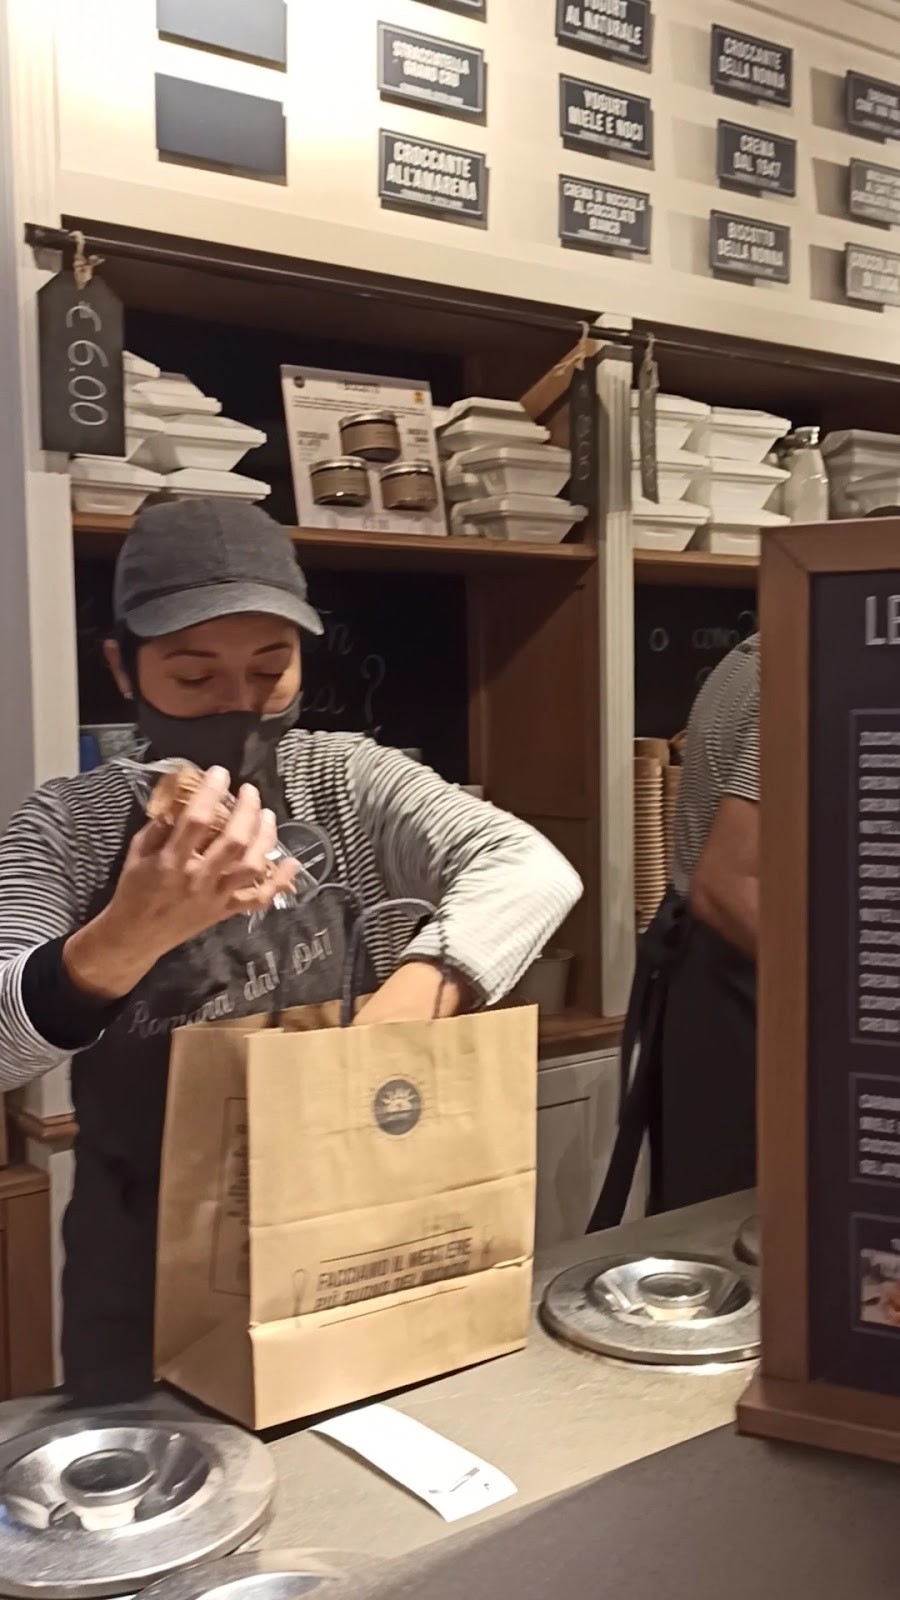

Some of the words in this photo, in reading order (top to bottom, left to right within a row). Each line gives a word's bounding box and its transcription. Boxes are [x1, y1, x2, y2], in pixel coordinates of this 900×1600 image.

[724, 37, 782, 70] CROCCANTE
[583, 90, 628, 117] YOGURT
[568, 106, 604, 132] MIELE
[605, 116, 614, 134] E
[616, 119, 643, 142] NOCI
[393, 141, 472, 178] CROCCANTE
[740, 135, 775, 159] CREMA
